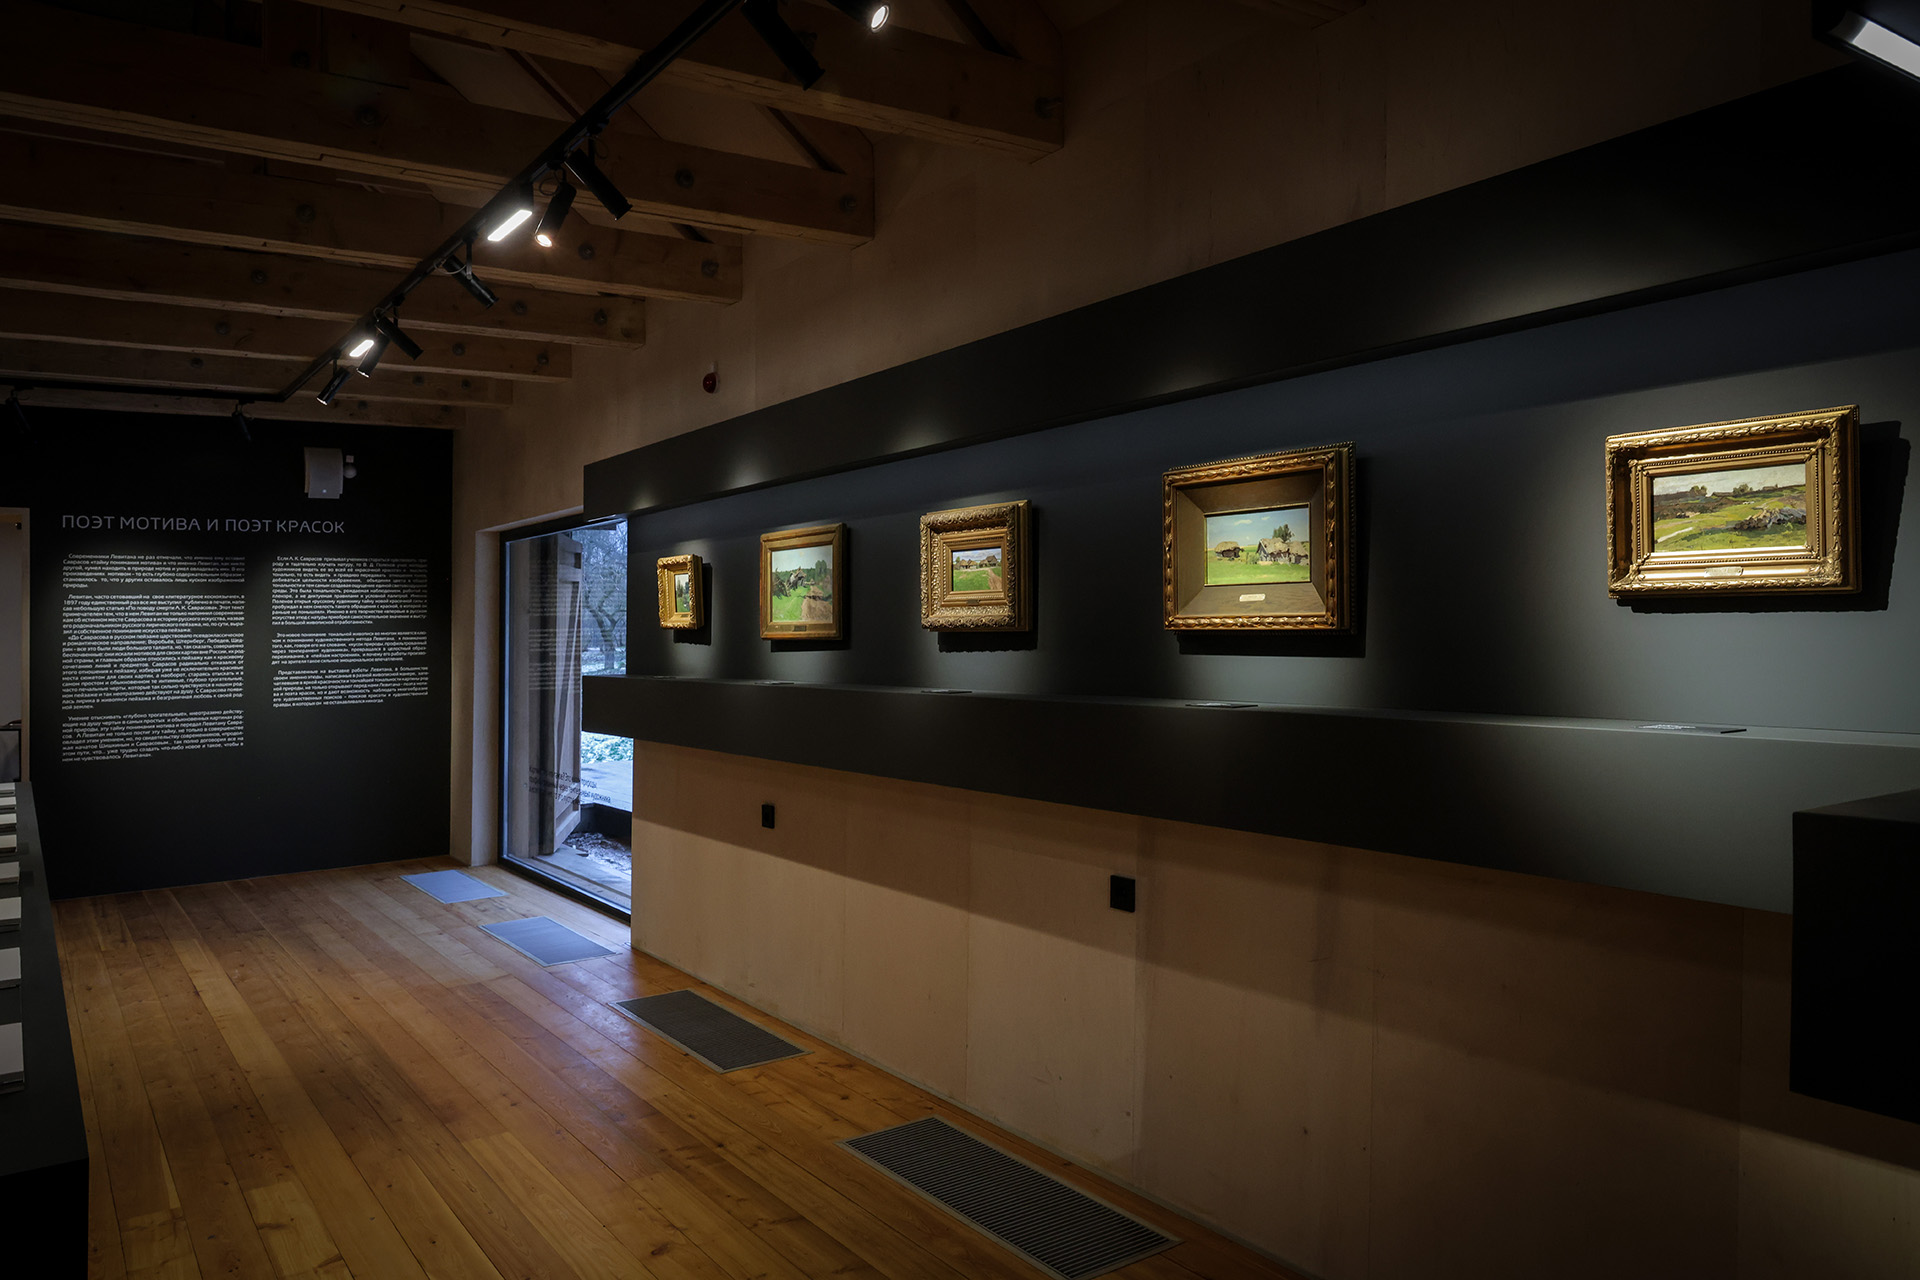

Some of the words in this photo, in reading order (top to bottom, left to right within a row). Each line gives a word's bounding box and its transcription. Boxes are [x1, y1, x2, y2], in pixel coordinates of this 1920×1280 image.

[62, 515, 115, 529] ПОЭТ
[120, 516, 201, 531] МОТИВА
[207, 518, 219, 531] И
[225, 519, 273, 532] ПОЭТ
[276, 520, 345, 534] КРАСОК
